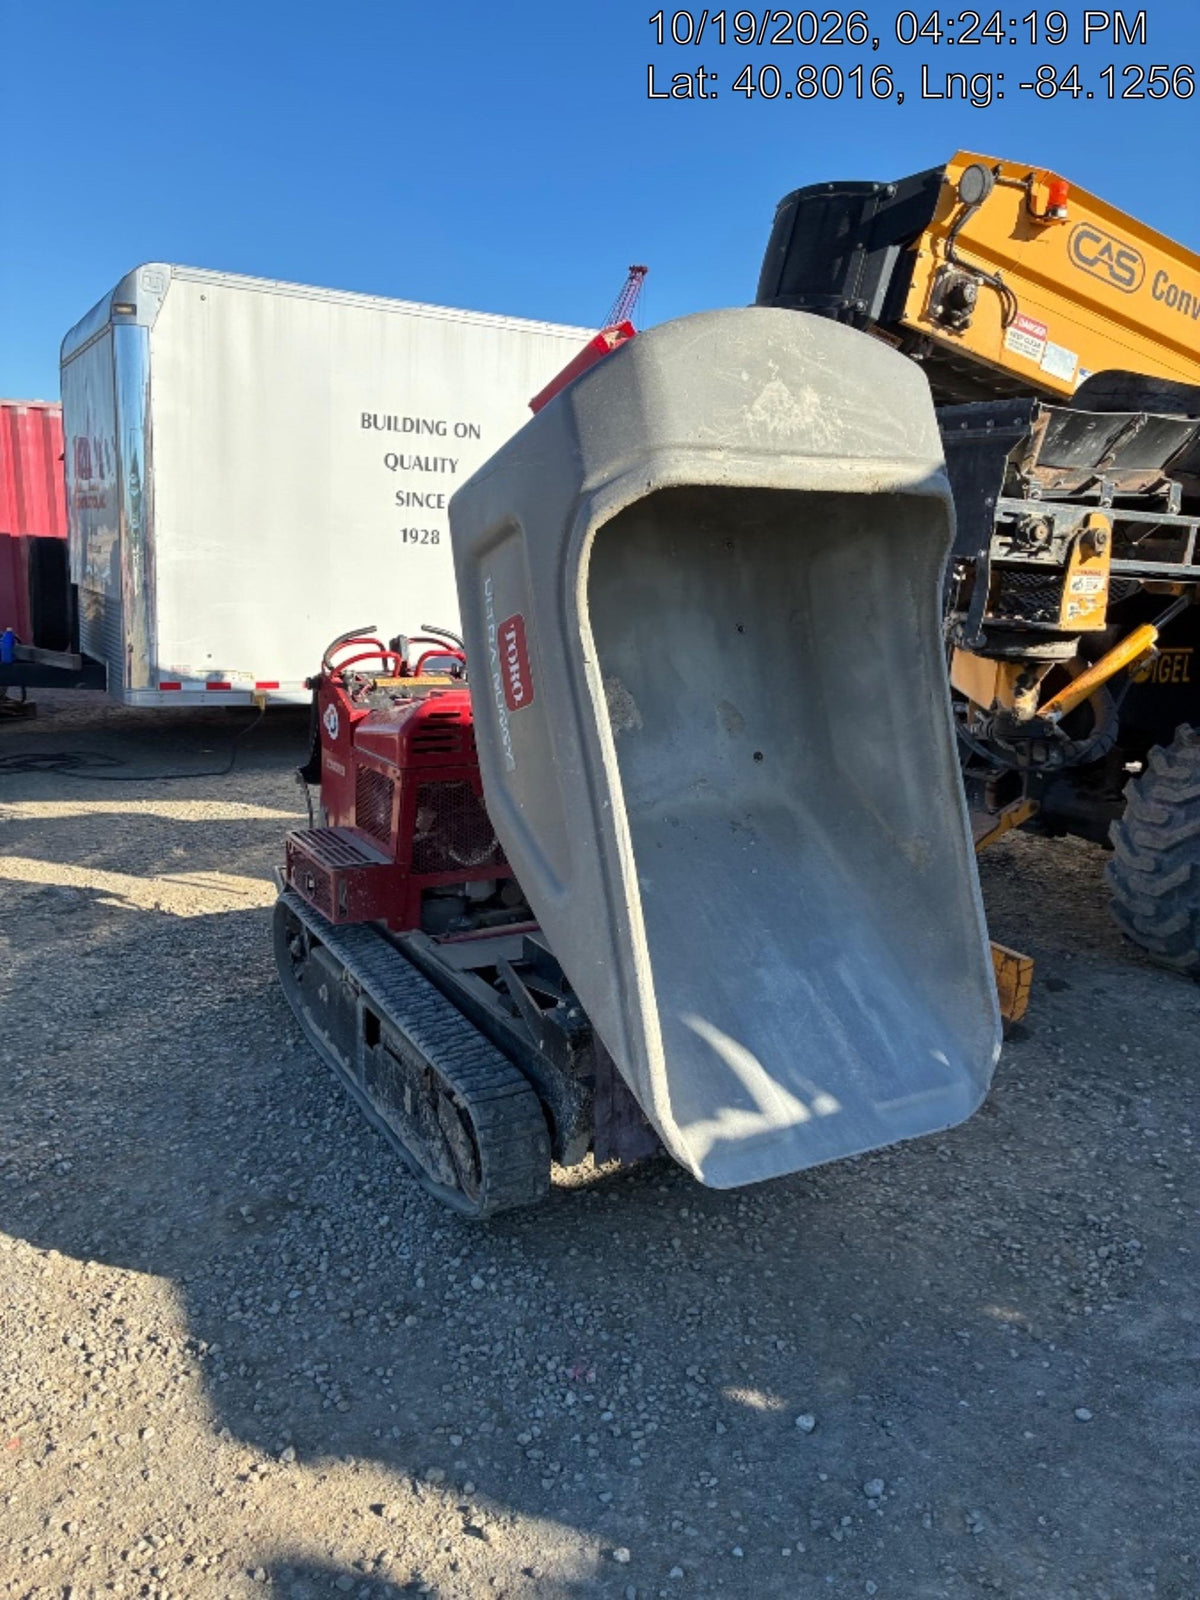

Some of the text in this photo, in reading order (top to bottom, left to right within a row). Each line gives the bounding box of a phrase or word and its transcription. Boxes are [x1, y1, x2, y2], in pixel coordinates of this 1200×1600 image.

[1073, 230, 1139, 287] CAS
[361, 412, 481, 439] BUILDING ON
[384, 452, 459, 474] QUALITY
[395, 490, 446, 509] SINCE
[400, 527, 440, 545] 1928
